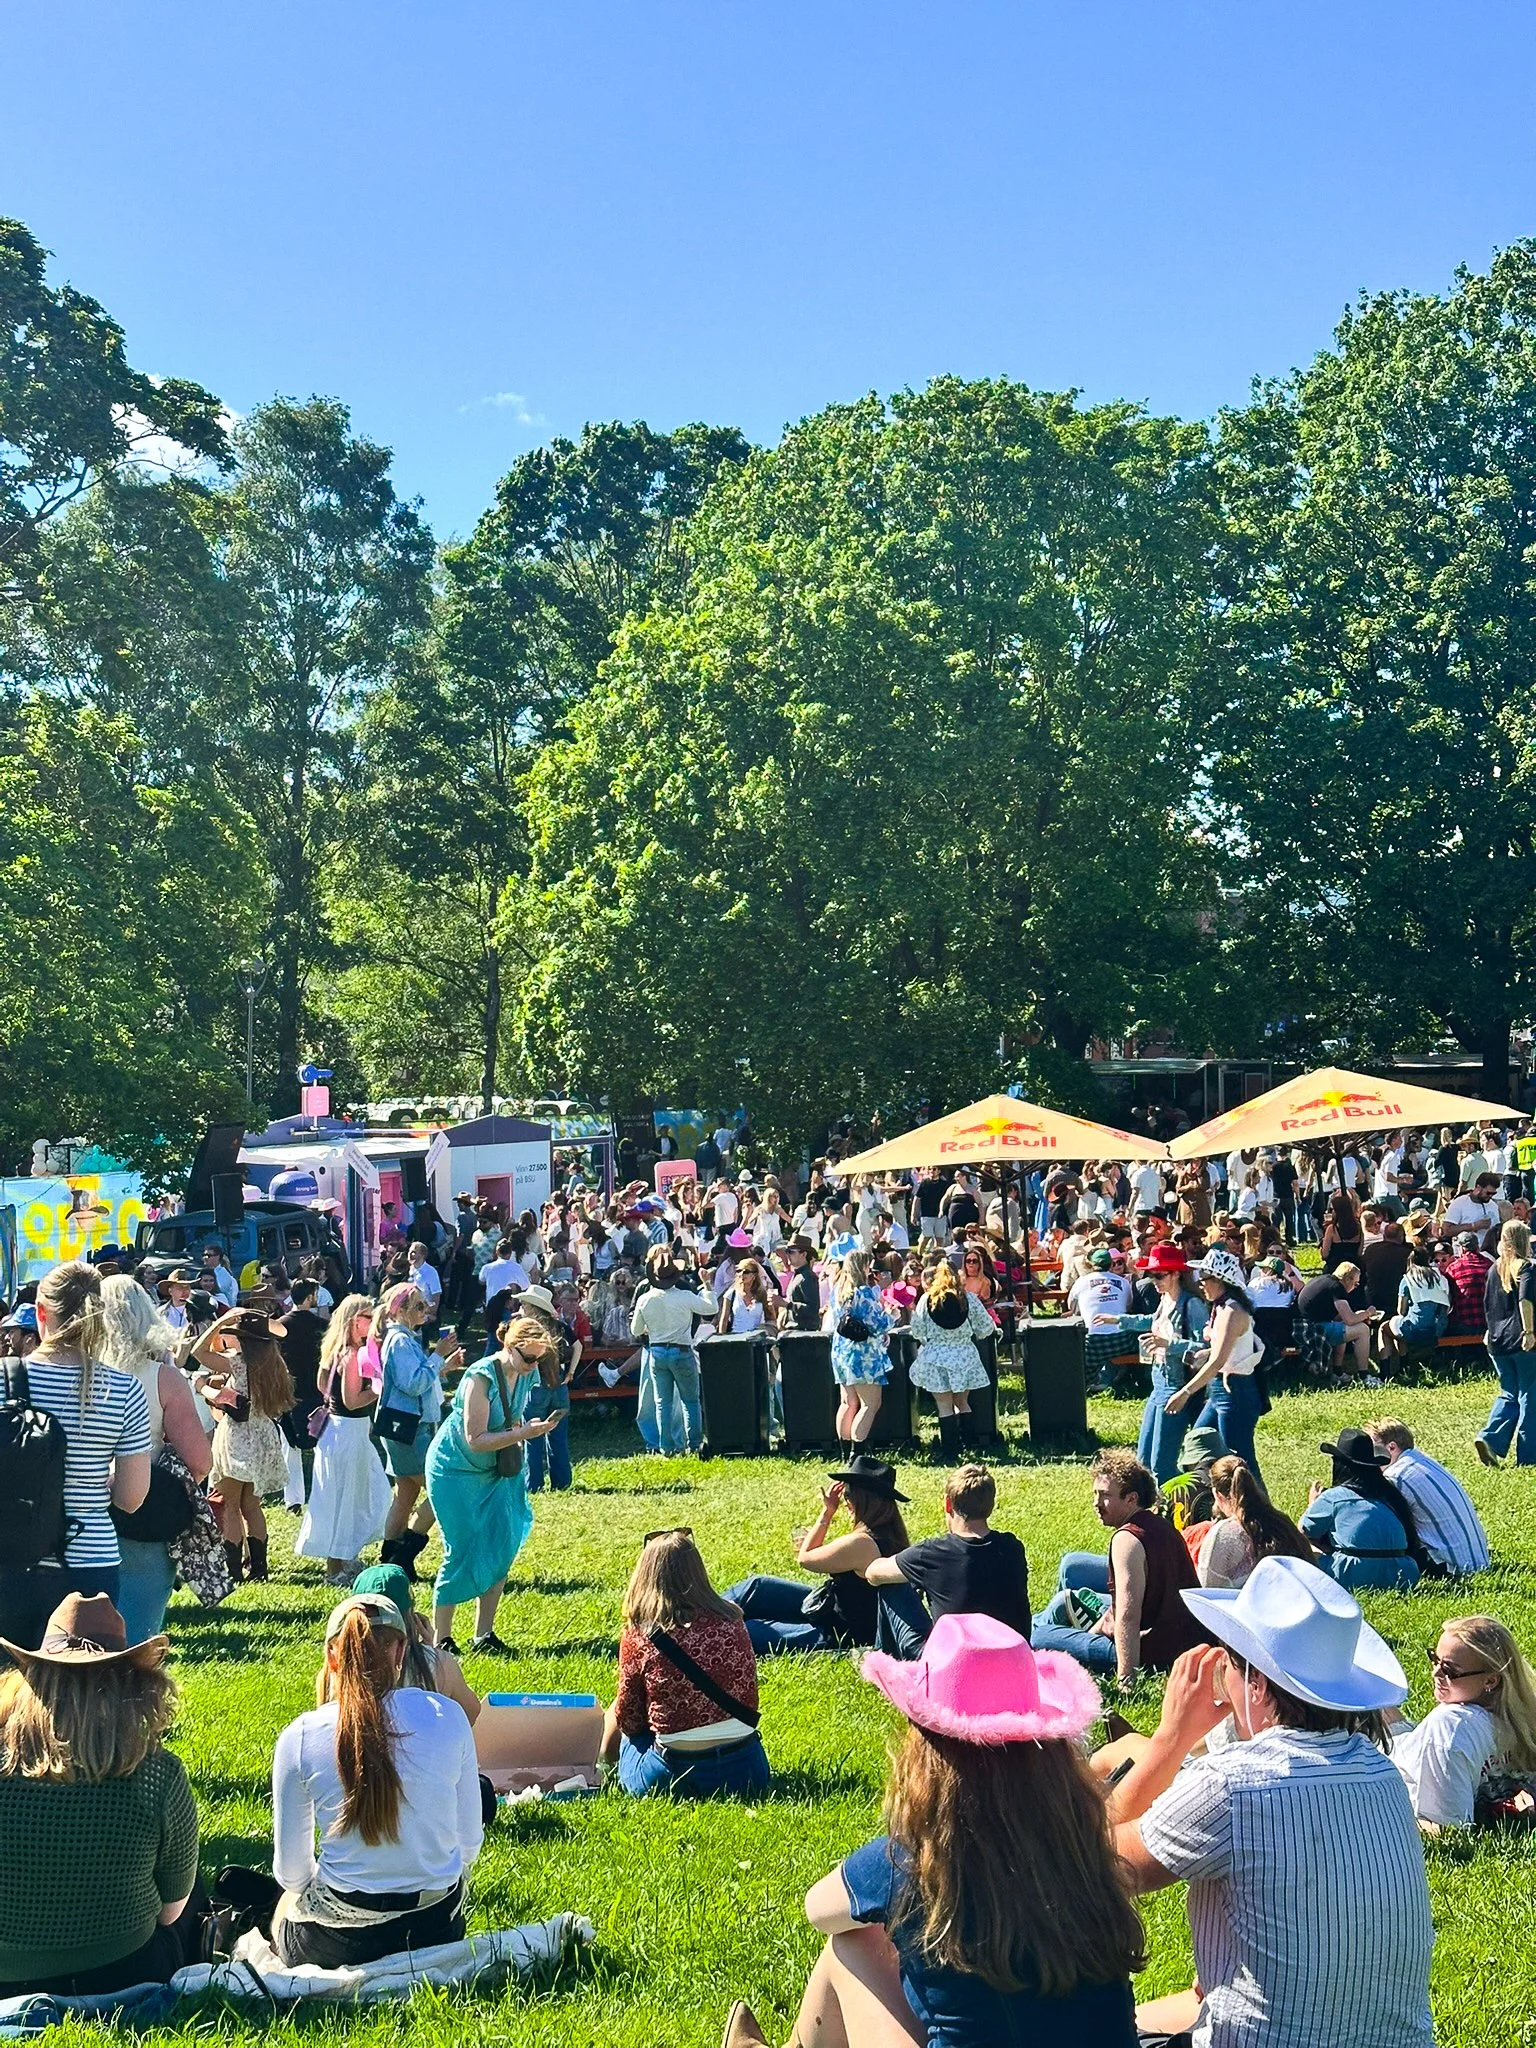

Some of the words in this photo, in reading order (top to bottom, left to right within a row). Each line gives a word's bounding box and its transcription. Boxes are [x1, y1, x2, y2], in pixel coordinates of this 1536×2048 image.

[1281, 1108, 1339, 1131] Red
[1344, 1104, 1402, 1117] Bull
[940, 1135, 995, 1152] Red
[1002, 1135, 1056, 1147] Bull
